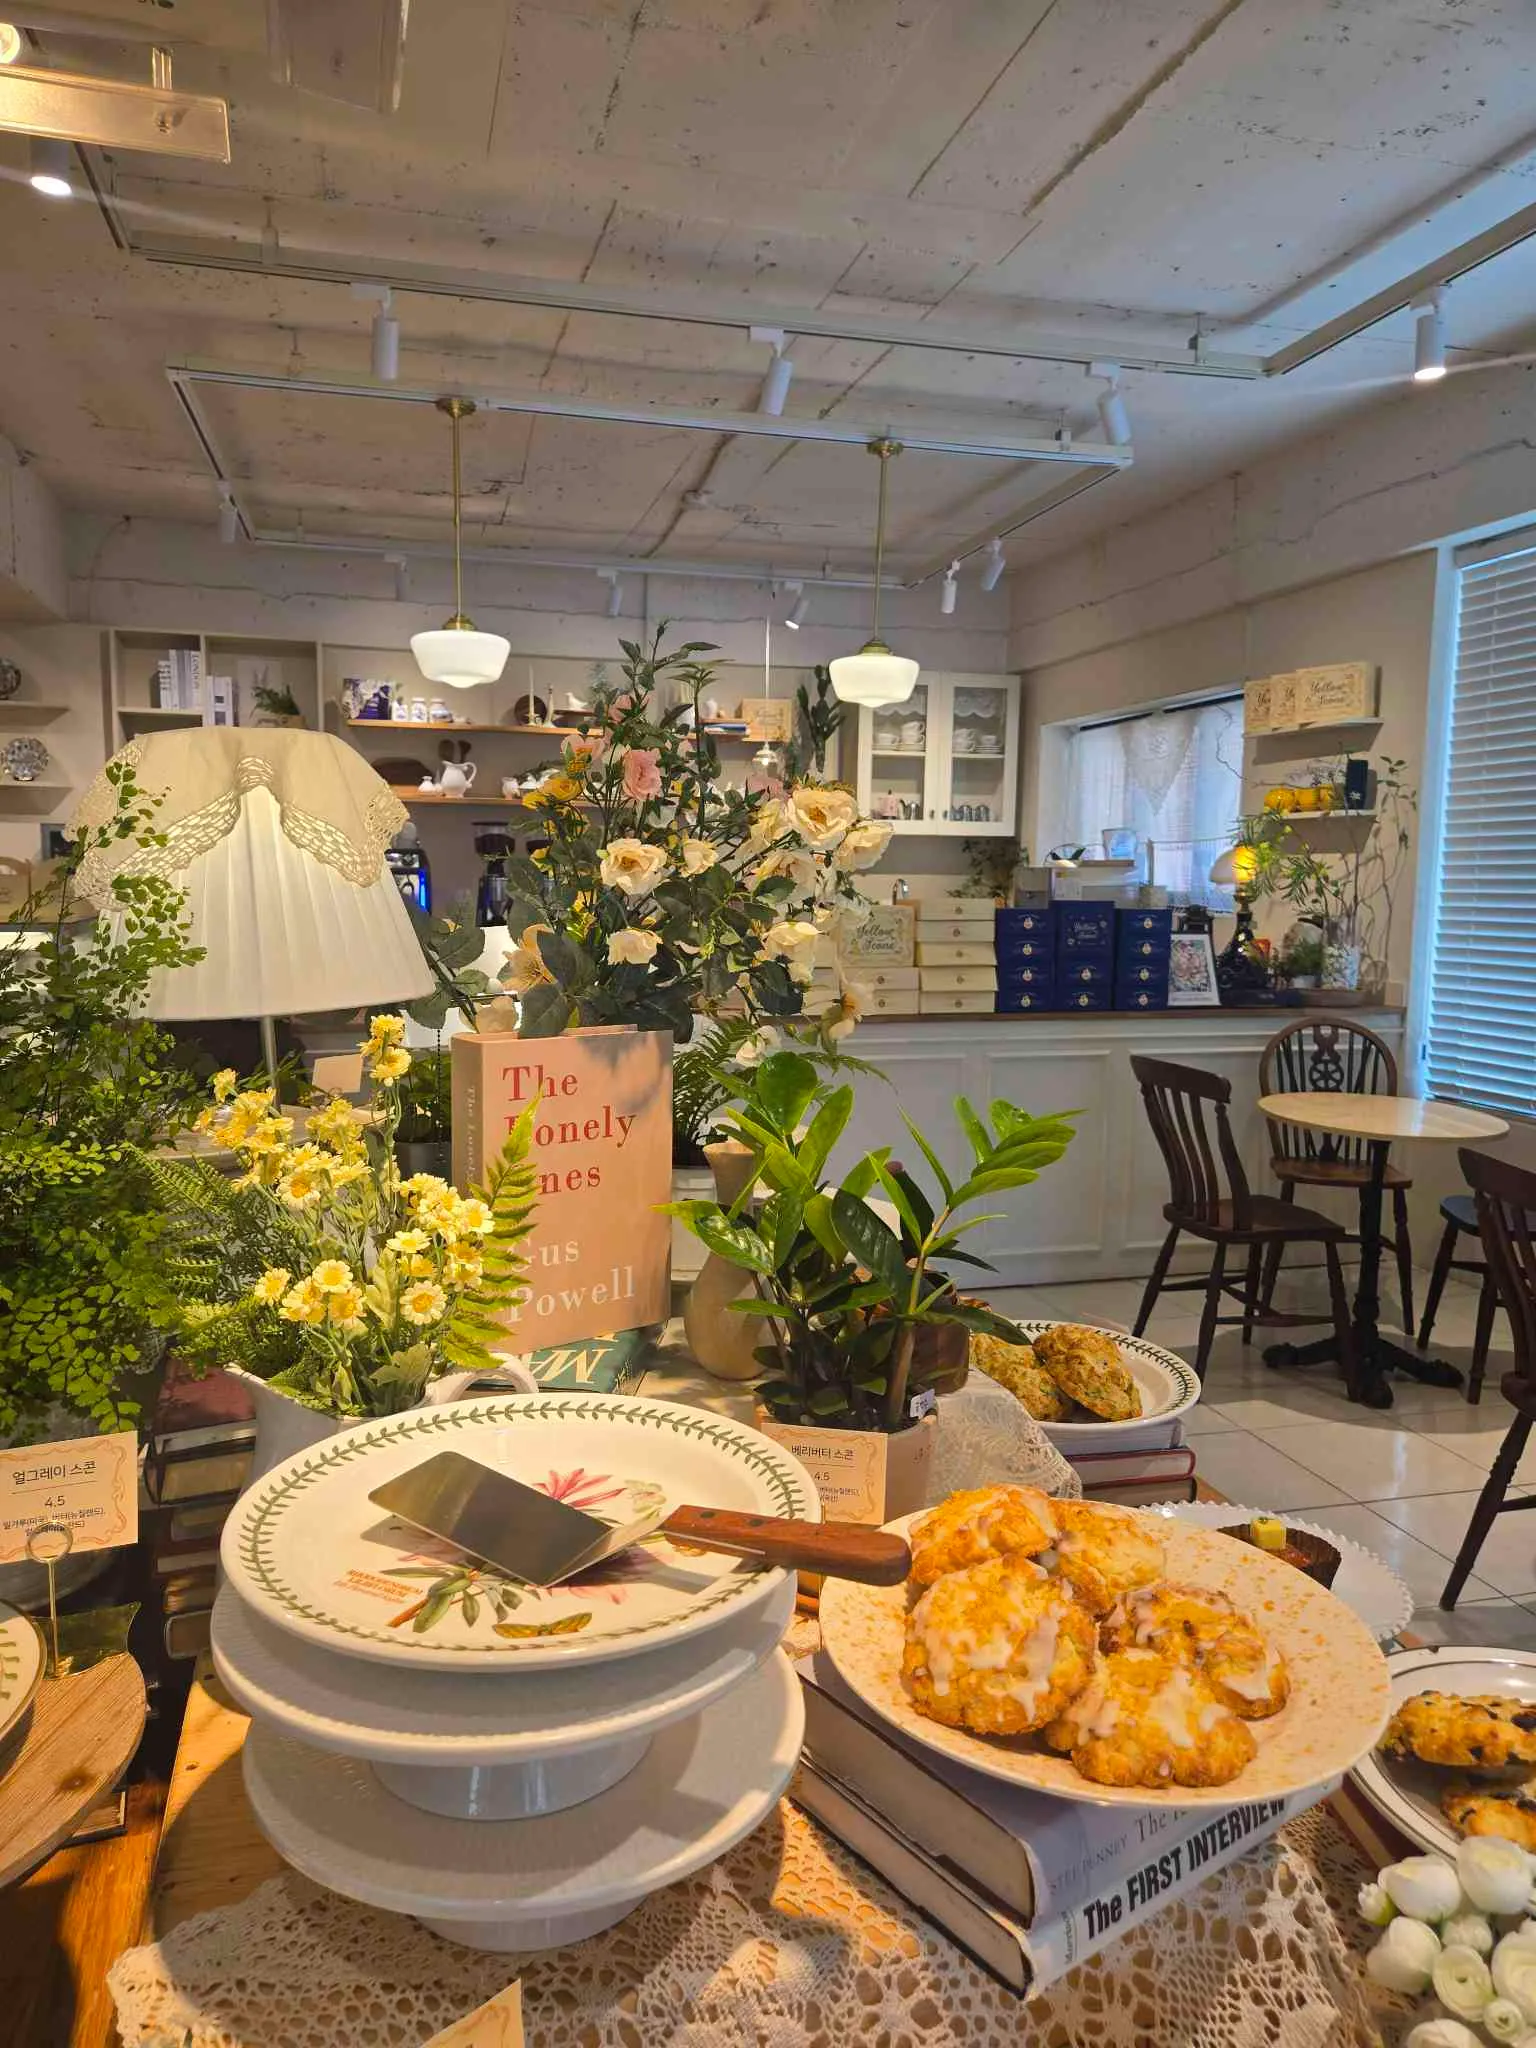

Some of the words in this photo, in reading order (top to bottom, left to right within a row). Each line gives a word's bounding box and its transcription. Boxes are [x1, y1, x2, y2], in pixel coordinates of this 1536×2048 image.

[502, 1064, 578, 1102] The
[538, 1165, 601, 1195] nes
[505, 1266, 635, 1324] Powell
[791, 1444, 831, 1460] 베리버터
[834, 1450, 854, 1461] 스콘
[12, 1464, 66, 1485] 얼그레이
[69, 1460, 97, 1475] 스콘
[44, 1495, 66, 1508] 4.5
[1134, 1811, 1167, 1843] The
[1083, 1894, 1122, 1940] The
[1126, 1846, 1183, 1913] FIRST
[1187, 1799, 1286, 1872] INTERVIEW
